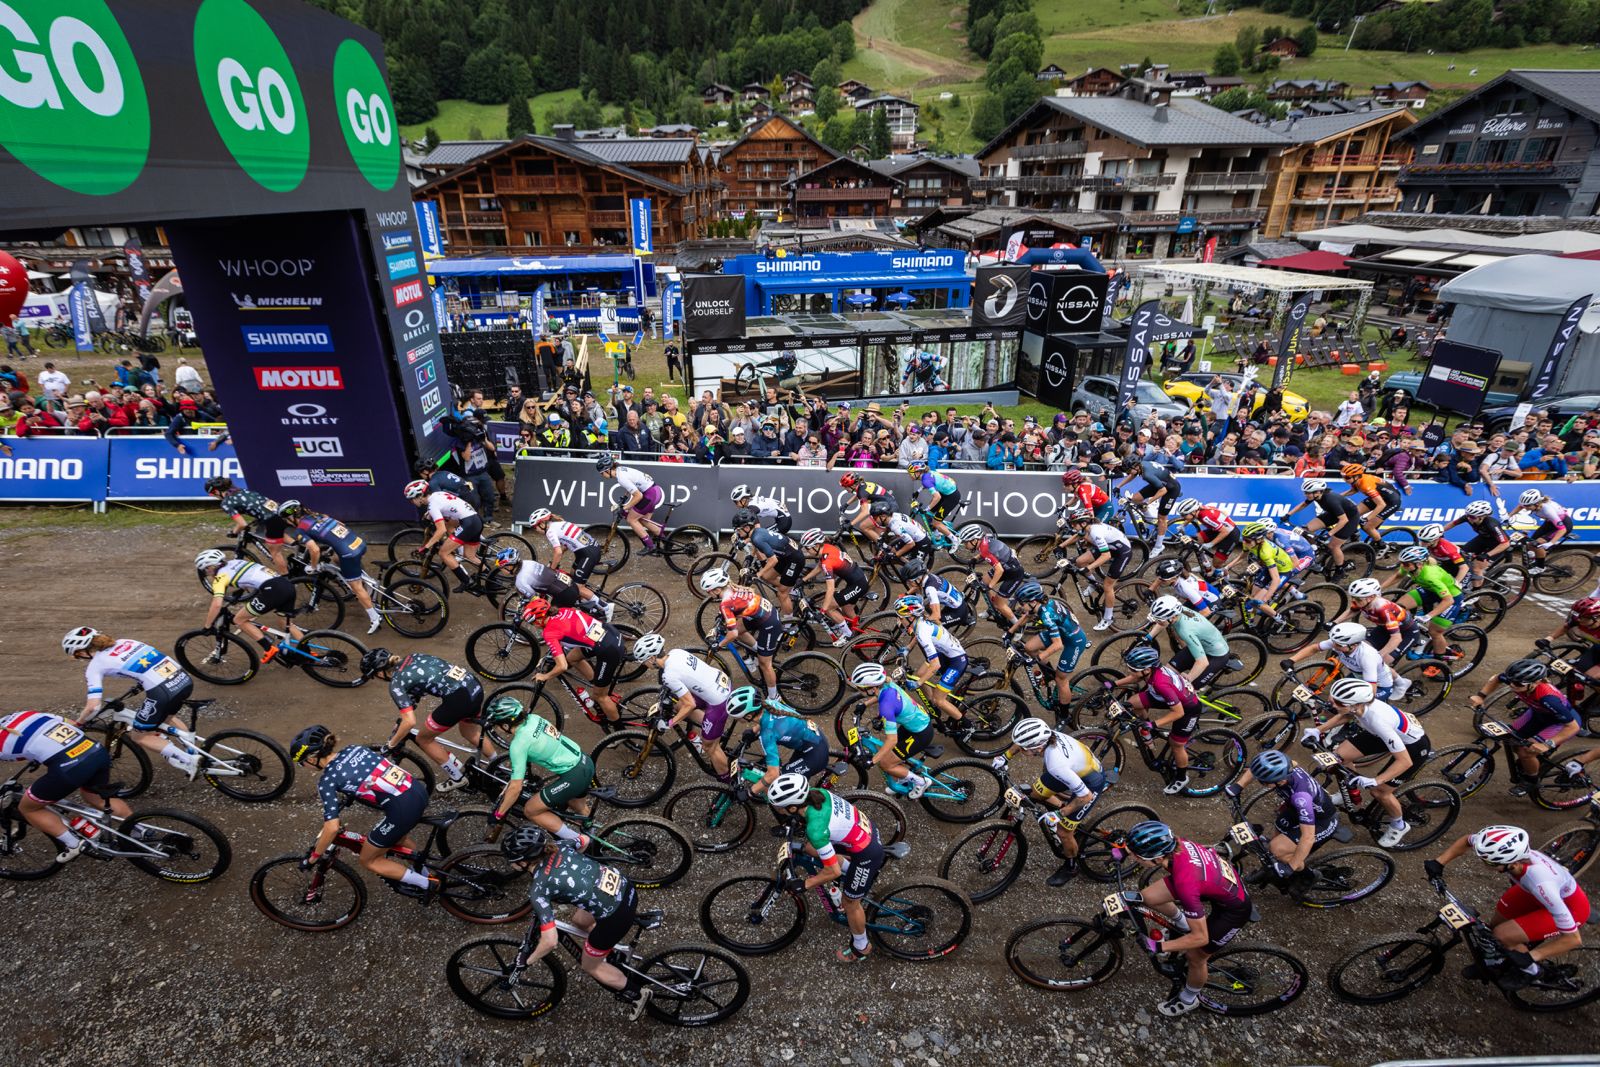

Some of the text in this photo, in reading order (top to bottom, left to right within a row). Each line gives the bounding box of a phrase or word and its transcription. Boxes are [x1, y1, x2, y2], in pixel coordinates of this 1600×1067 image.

[0, 1, 125, 118] GO
[217, 57, 296, 136] GO
[346, 87, 392, 147] GO
[1481, 118, 1528, 134] Bellevue
[376, 210, 408, 228] WHOOP
[422, 201, 435, 245] MICHELIN
[639, 200, 648, 241] MICHELIN
[391, 235, 412, 245] MICHELIN
[218, 258, 313, 277] WHOOP
[389, 257, 416, 274] SHIMANO
[756, 260, 821, 273] SHIMANO
[893, 255, 953, 269] SHIMANO
[257, 296, 322, 307] MICHELIN
[395, 283, 423, 305] MOTUL
[695, 299, 730, 308] UNLOCK
[1028, 297, 1048, 308] NISSAN
[1057, 300, 1099, 310] NISSAN
[75, 289, 85, 332] MICHELIN
[692, 307, 734, 316] YOURSELF
[247, 332, 328, 345] SHIMANO
[403, 323, 431, 342] OAKLEY
[1151, 331, 1192, 341] NISSAN
[1122, 310, 1151, 407] NISSAN
[418, 365, 434, 384] CIC
[1045, 362, 1067, 377] NISSAN
[261, 370, 339, 387] MOTUL
[427, 393, 440, 409] UCI
[281, 417, 338, 425] OAKLEY
[1425, 432, 1438, 441] 20m
[302, 440, 338, 453] UCI
[542, 478, 690, 508] WHOP
[843, 586, 862, 601] BMC
[1223, 586, 1234, 598] 40
[452, 668, 463, 678] 14
[1553, 661, 1567, 672] 54
[943, 669, 957, 683] KMC
[1295, 689, 1308, 699] 47
[916, 689, 938, 717] RIDLEY
[1110, 704, 1118, 716] 36
[55, 727, 73, 739] 12
[849, 731, 856, 742] 34
[1487, 723, 1502, 735] 63
[349, 749, 369, 768] Ford
[1319, 752, 1333, 763] 55
[391, 771, 399, 780] 3
[1006, 790, 1018, 805] 33
[380, 822, 395, 836] Ford
[1235, 826, 1249, 841] 43
[159, 868, 214, 879] BONTRAGER
[851, 866, 863, 891] SANTA
[860, 867, 870, 887] CRUZ
[605, 873, 617, 892] 32
[1107, 897, 1118, 913] 23
[1444, 907, 1465, 925] 57
